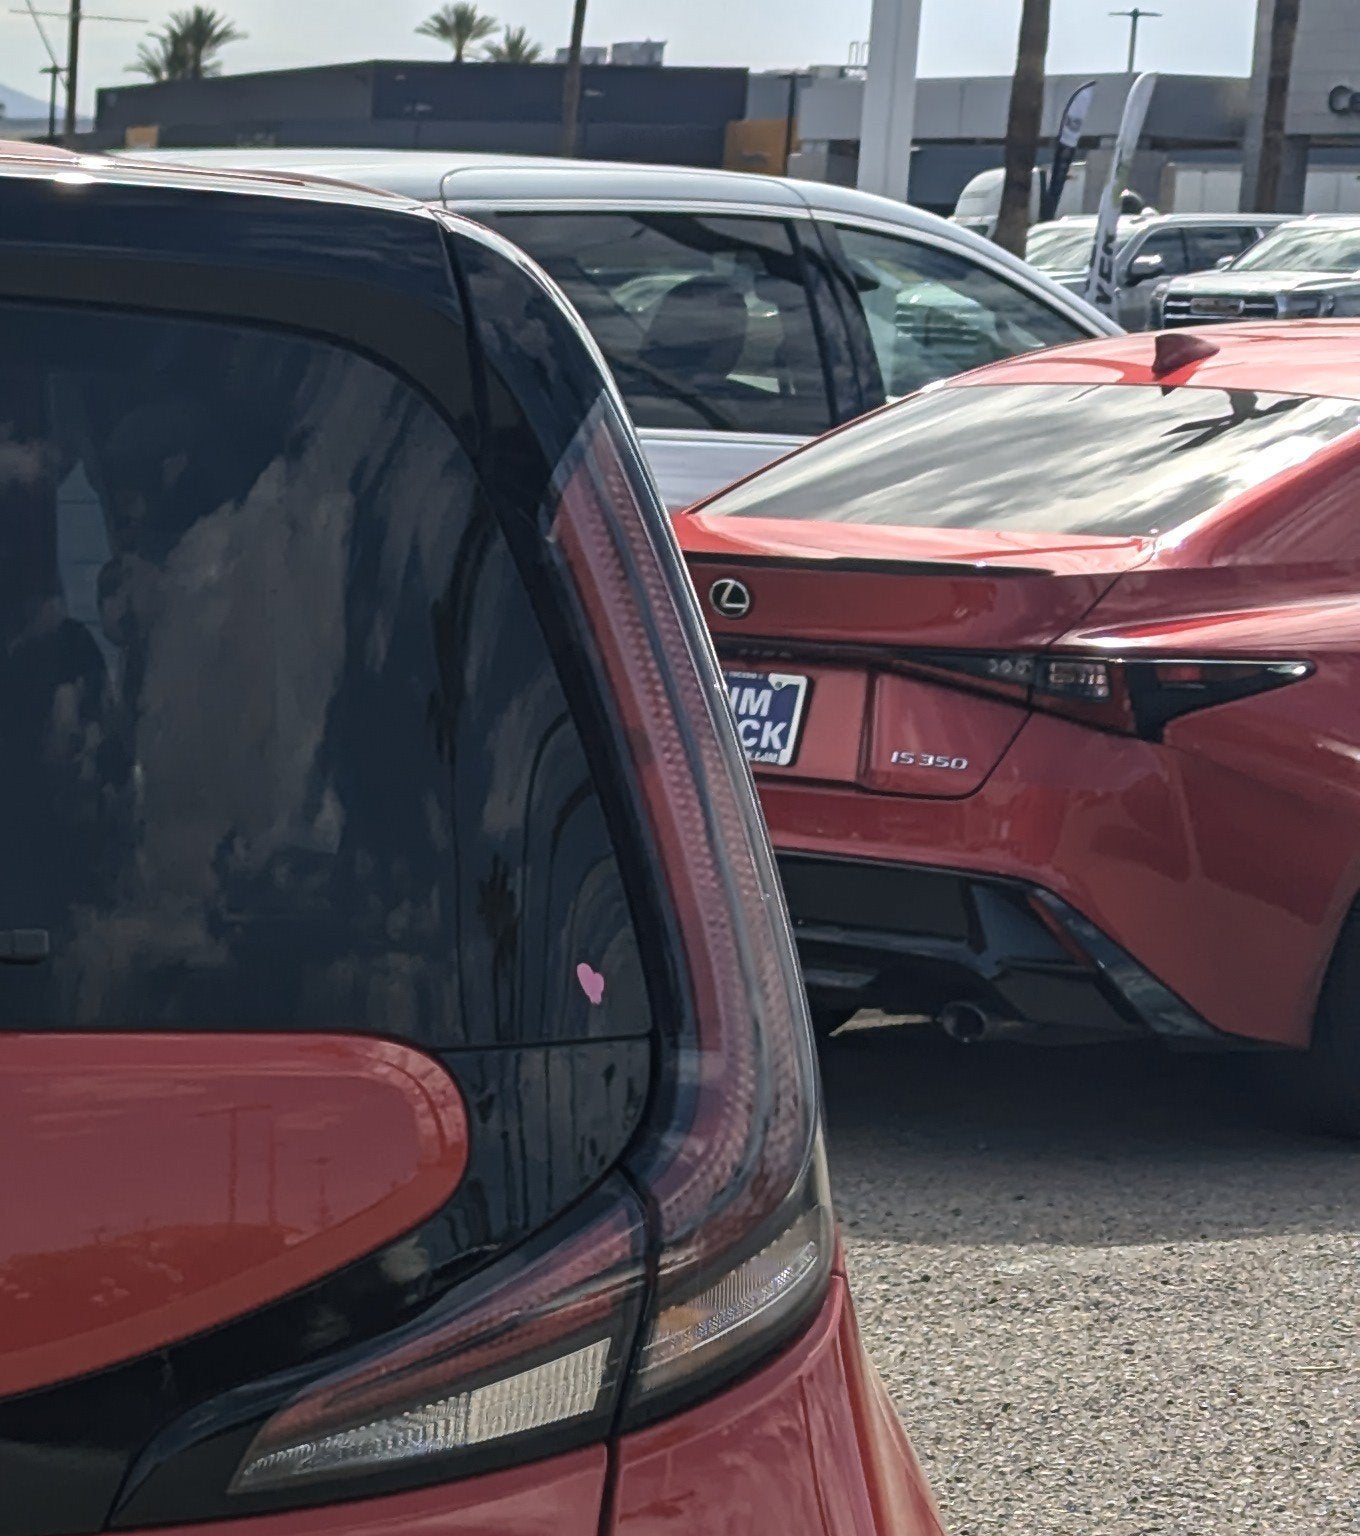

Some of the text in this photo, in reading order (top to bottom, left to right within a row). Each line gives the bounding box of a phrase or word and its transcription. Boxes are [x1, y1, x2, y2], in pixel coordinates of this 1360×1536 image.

[728, 686, 773, 717] IM
[890, 750, 969, 770] IS 350
